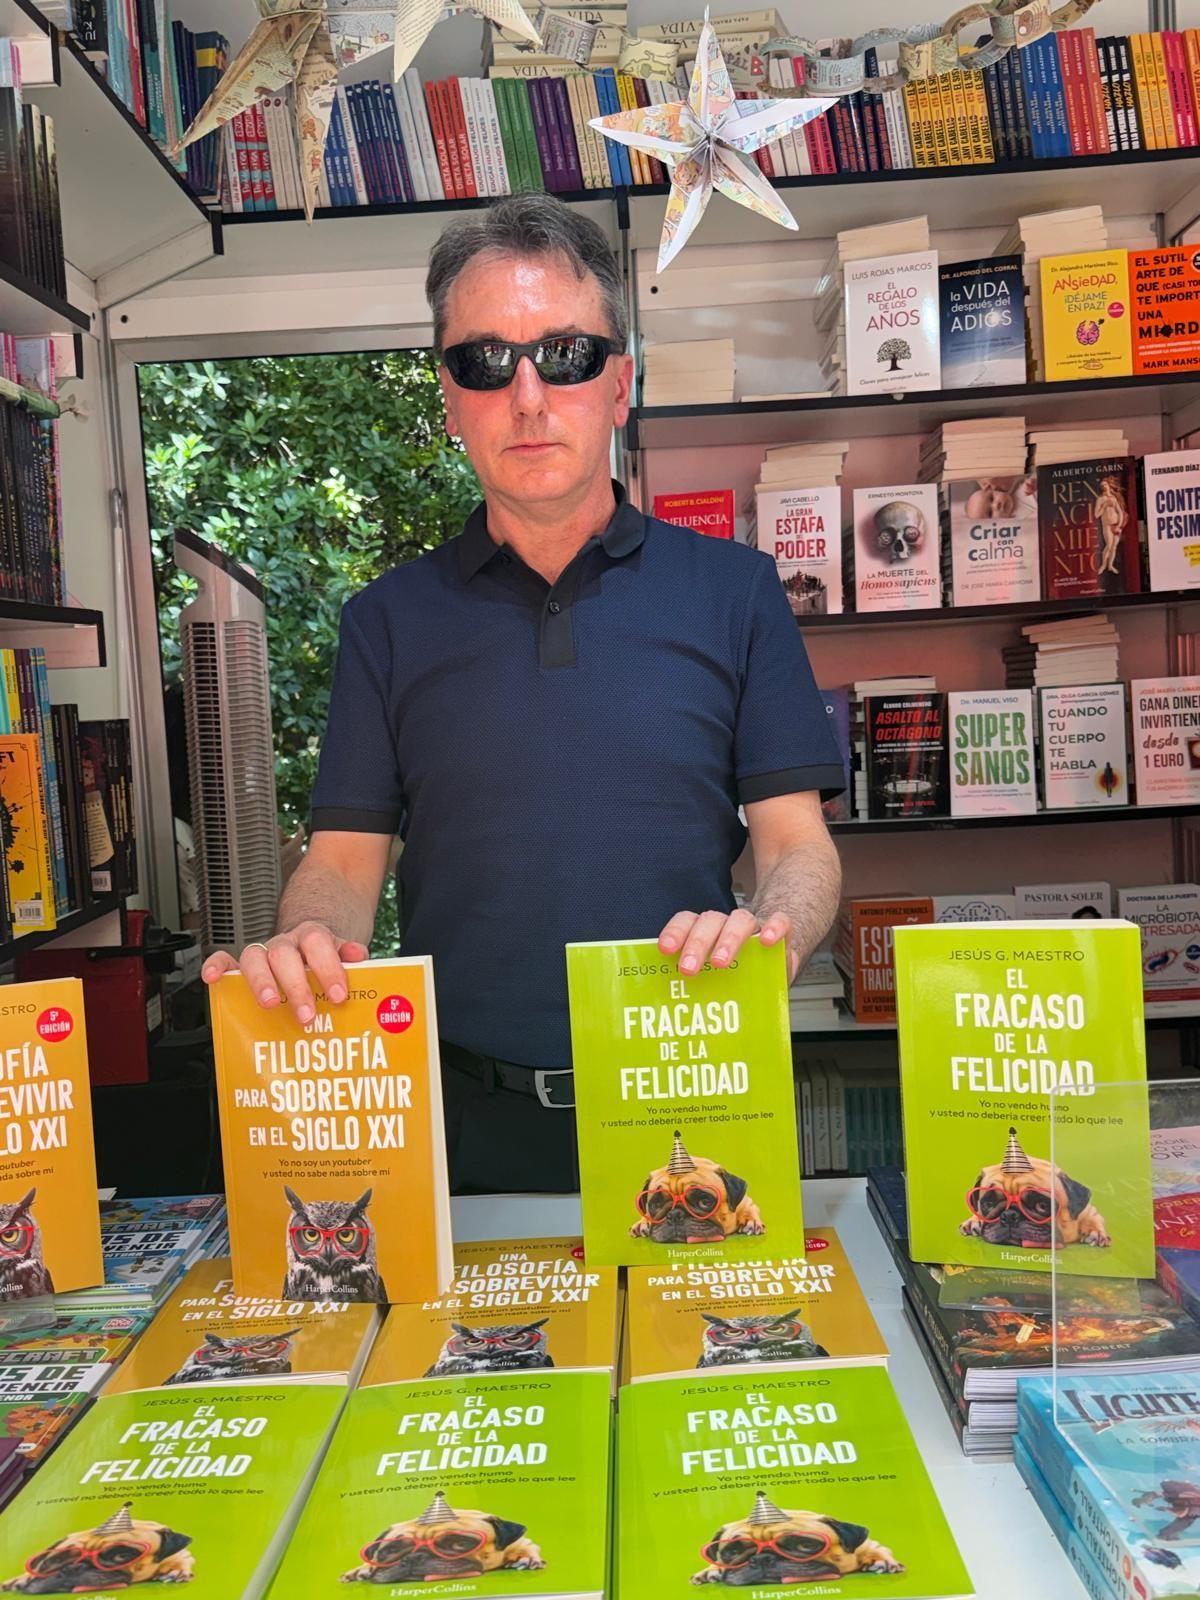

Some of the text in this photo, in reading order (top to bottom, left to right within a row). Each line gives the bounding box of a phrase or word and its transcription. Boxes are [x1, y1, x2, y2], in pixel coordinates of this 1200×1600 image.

[514, 66, 548, 77] VIDA
[1136, 254, 1188, 267] EL SUTIL
[852, 262, 932, 280] LUIS ROJAS MARCOS
[1136, 266, 1184, 280] ARTE DE
[888, 282, 896, 290] EL
[950, 280, 1010, 302] la VIDA
[1136, 282, 1160, 294] QUE
[867, 287, 918, 304] REGALO
[1137, 296, 1152, 306] TE
[879, 300, 907, 311] DE LOS
[951, 297, 1011, 315] después del
[1068, 302, 1106, 313] EN PAZ!
[866, 310, 920, 332] AÑOS
[951, 309, 1012, 333] ADIÓS
[1138, 310, 1164, 321] UNA
[1144, 361, 1170, 370] MARK
[1052, 466, 1094, 478] ALBERTO
[1151, 463, 1200, 476] FERNANDO DÍAZ
[664, 500, 690, 508] ROBERT
[696, 496, 724, 505] CIALDINI
[780, 495, 820, 505] JAVI CABELLO
[786, 508, 813, 518] LA GRAN
[776, 516, 825, 536] ESTAFA
[970, 522, 1022, 541] Criar
[775, 538, 826, 561] PODER
[997, 538, 1014, 546] con
[968, 542, 1024, 562] calma
[878, 568, 914, 578] MUERTE
[860, 576, 938, 592] Homo sapiens
[972, 698, 1001, 706] MANUEL
[1002, 696, 1018, 704] VISO
[1140, 697, 1170, 711] GANA
[876, 710, 940, 725] ASALTO AL
[1048, 706, 1108, 719] CUANDO
[875, 726, 943, 742] OCTÁGONO
[954, 712, 1027, 749] SUPER
[1048, 722, 1066, 732] TU
[1048, 732, 1106, 745] CUERPO
[1142, 732, 1179, 749] desde
[1049, 748, 1065, 758] TE
[1144, 753, 1184, 768] 1 EURO
[954, 749, 1030, 786] SANOS
[1050, 760, 1098, 771] HABLA
[1024, 891, 1104, 903] PASTORA SOLER
[1156, 904, 1170, 912] LA
[949, 948, 1084, 962] JESÚS MAESTRO
[618, 964, 656, 977] JESÚS
[1006, 968, 1028, 989] EL
[670, 980, 690, 1000] EL
[380, 1011, 411, 1025] EDICIÓN
[954, 992, 1085, 1030] FRACASO
[623, 1000, 740, 1040] FRACASO
[40, 1022, 71, 1035] EDICIÓN
[660, 1040, 708, 1062] DE LA
[994, 1033, 1049, 1054] DE LA
[254, 1030, 389, 1074] FILOSOFÍA
[620, 1061, 749, 1102] FELICIDAD
[951, 1056, 1096, 1096] FELICIDAD
[235, 1074, 412, 1114] PARA SOBREVIVIR
[672, 1104, 727, 1114] vendo humo
[29, 1116, 68, 1152] XXI
[249, 1114, 405, 1152] EN EL SIGLO XXI
[279, 1158, 290, 1167] Yo
[304, 1160, 318, 1170] soy
[332, 1158, 372, 1170] youtuber
[499, 1253, 528, 1262] UNA
[668, 1248, 724, 1260] HarperCollins
[454, 1274, 600, 1294] SOBREVIVIR
[648, 1264, 836, 1288] PARA SOBREVIVIR
[662, 1278, 833, 1300] EN EL SIGLO XXI
[446, 1300, 464, 1309] EL
[469, 1290, 544, 1309] SIGLO
[550, 1288, 589, 1304] XXI
[1072, 1343, 1131, 1352] PROBERT
[40, 1365, 93, 1381] DE
[405, 1382, 552, 1400] JESÚS MAESTRO
[680, 1380, 831, 1397] JESÚS MAESTRO
[464, 1395, 488, 1408] EL
[746, 1392, 772, 1406] EL
[398, 1404, 546, 1435] FRACASO
[687, 1402, 839, 1434] FRACASO
[118, 1416, 269, 1444] FRACASO
[436, 1430, 498, 1446] DE LA
[734, 1428, 799, 1445] DE LA
[150, 1440, 212, 1456] DE LA
[376, 1442, 548, 1477] FELICIDAD
[681, 1440, 858, 1476] FELICIDAD
[80, 1454, 253, 1484] FELICIDAD
[1081, 1489, 1120, 1562] LIGHTFALL
[391, 1583, 477, 1598] HarperCollins
[752, 1584, 843, 1600] HarperCollins
